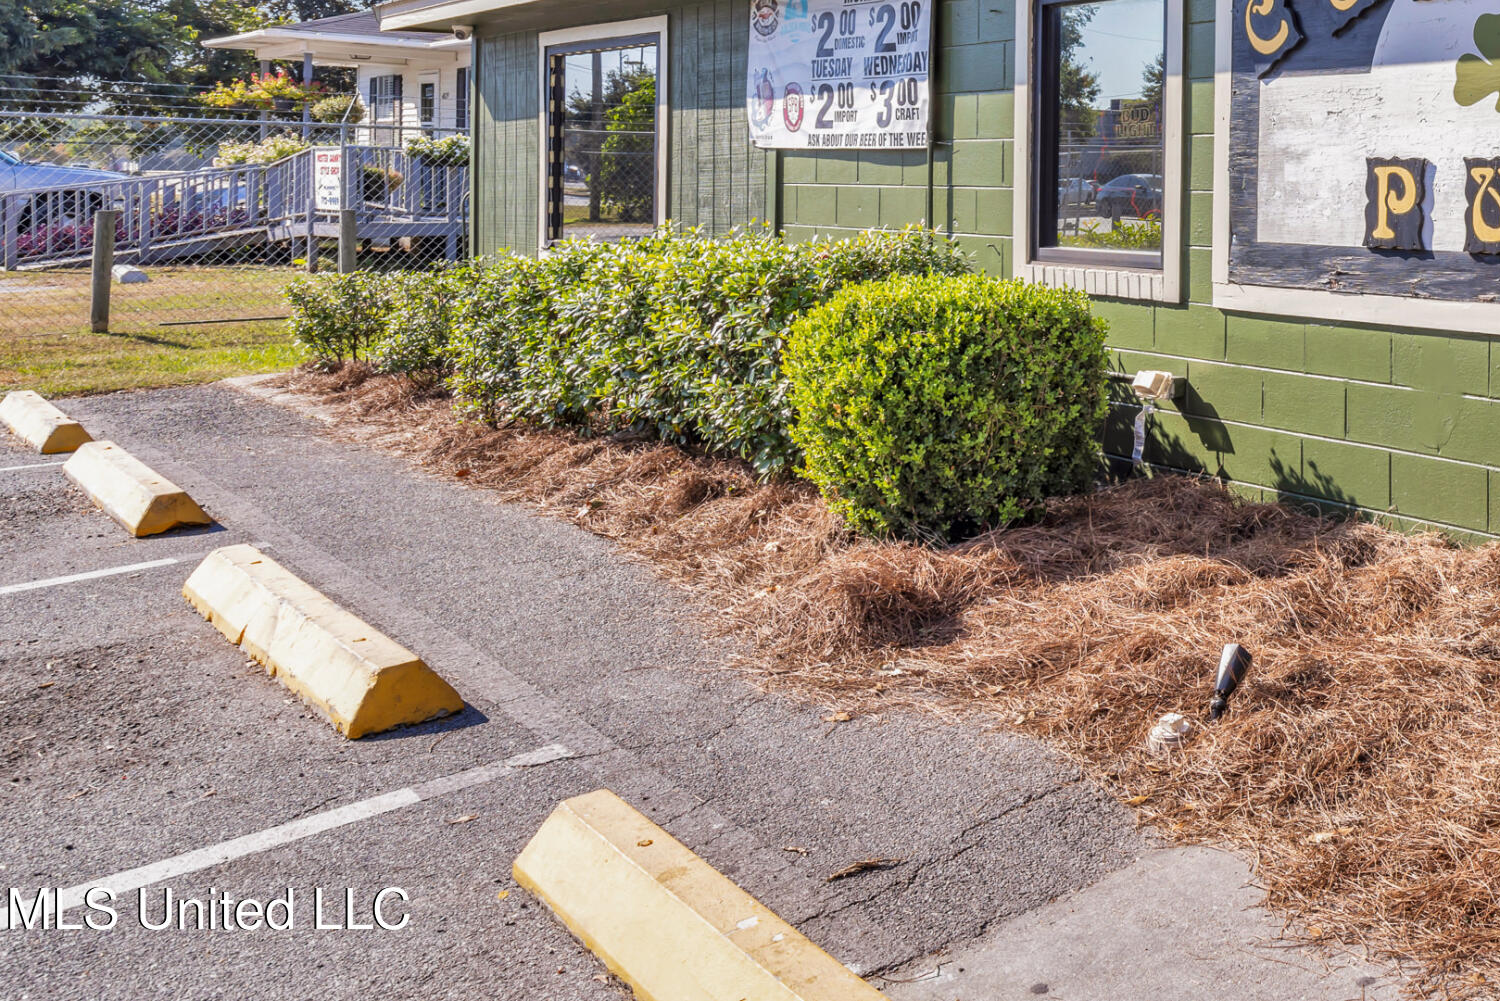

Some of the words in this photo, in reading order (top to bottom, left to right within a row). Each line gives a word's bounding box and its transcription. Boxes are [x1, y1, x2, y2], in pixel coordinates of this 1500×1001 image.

[811, 57, 853, 78] TUESDAY
[863, 51, 928, 76] WEDNESDAY
[834, 110, 858, 123] IMPORT
[895, 108, 920, 121] CRAFT
[808, 134, 820, 147] ASK
[822, 133, 843, 147] ABOUT
[844, 133, 858, 147] OUR
[860, 133, 877, 147] BEER
[878, 132, 888, 146] OF
[889, 132, 904, 146] THE
[906, 132, 928, 146] WEE
